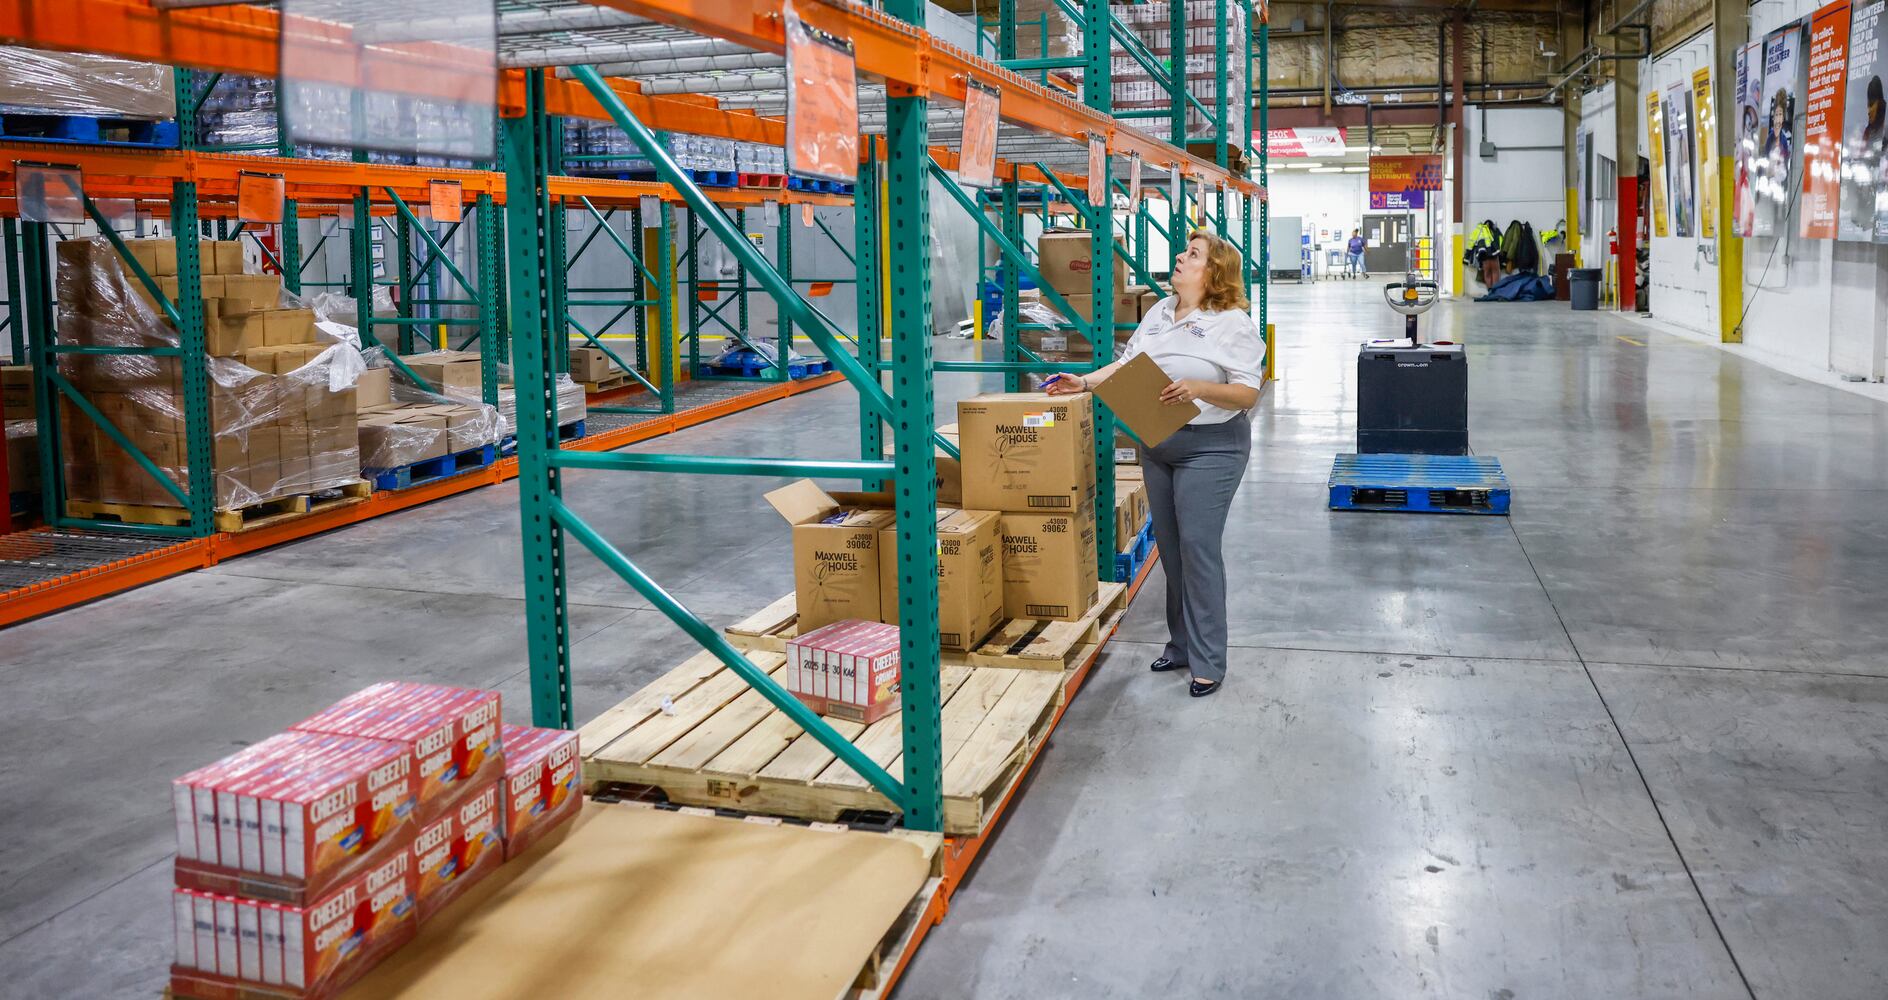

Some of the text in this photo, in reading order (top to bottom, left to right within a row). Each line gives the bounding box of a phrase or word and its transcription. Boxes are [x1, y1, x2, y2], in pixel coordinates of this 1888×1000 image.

[1854, 1, 1885, 23] VOLUNTEER
[1854, 15, 1878, 35] TODAY TO
[1853, 28, 1873, 46] HELP US
[1830, 45, 1842, 59] food
[1851, 38, 1879, 58] MAKE OUR
[1873, 50, 1878, 63] A
[152, 225, 158, 237] 4
[996, 425, 1037, 434] MAXWELL
[1009, 435, 1038, 444] HOUSE
[846, 541, 871, 549] 39062
[1010, 545, 1037, 554] HOUSE
[815, 551, 857, 561] MAXWELL
[828, 562, 857, 571] HOUSE
[804, 660, 819, 670] 2025
[822, 664, 829, 672] DE
[832, 665, 840, 674] 30
